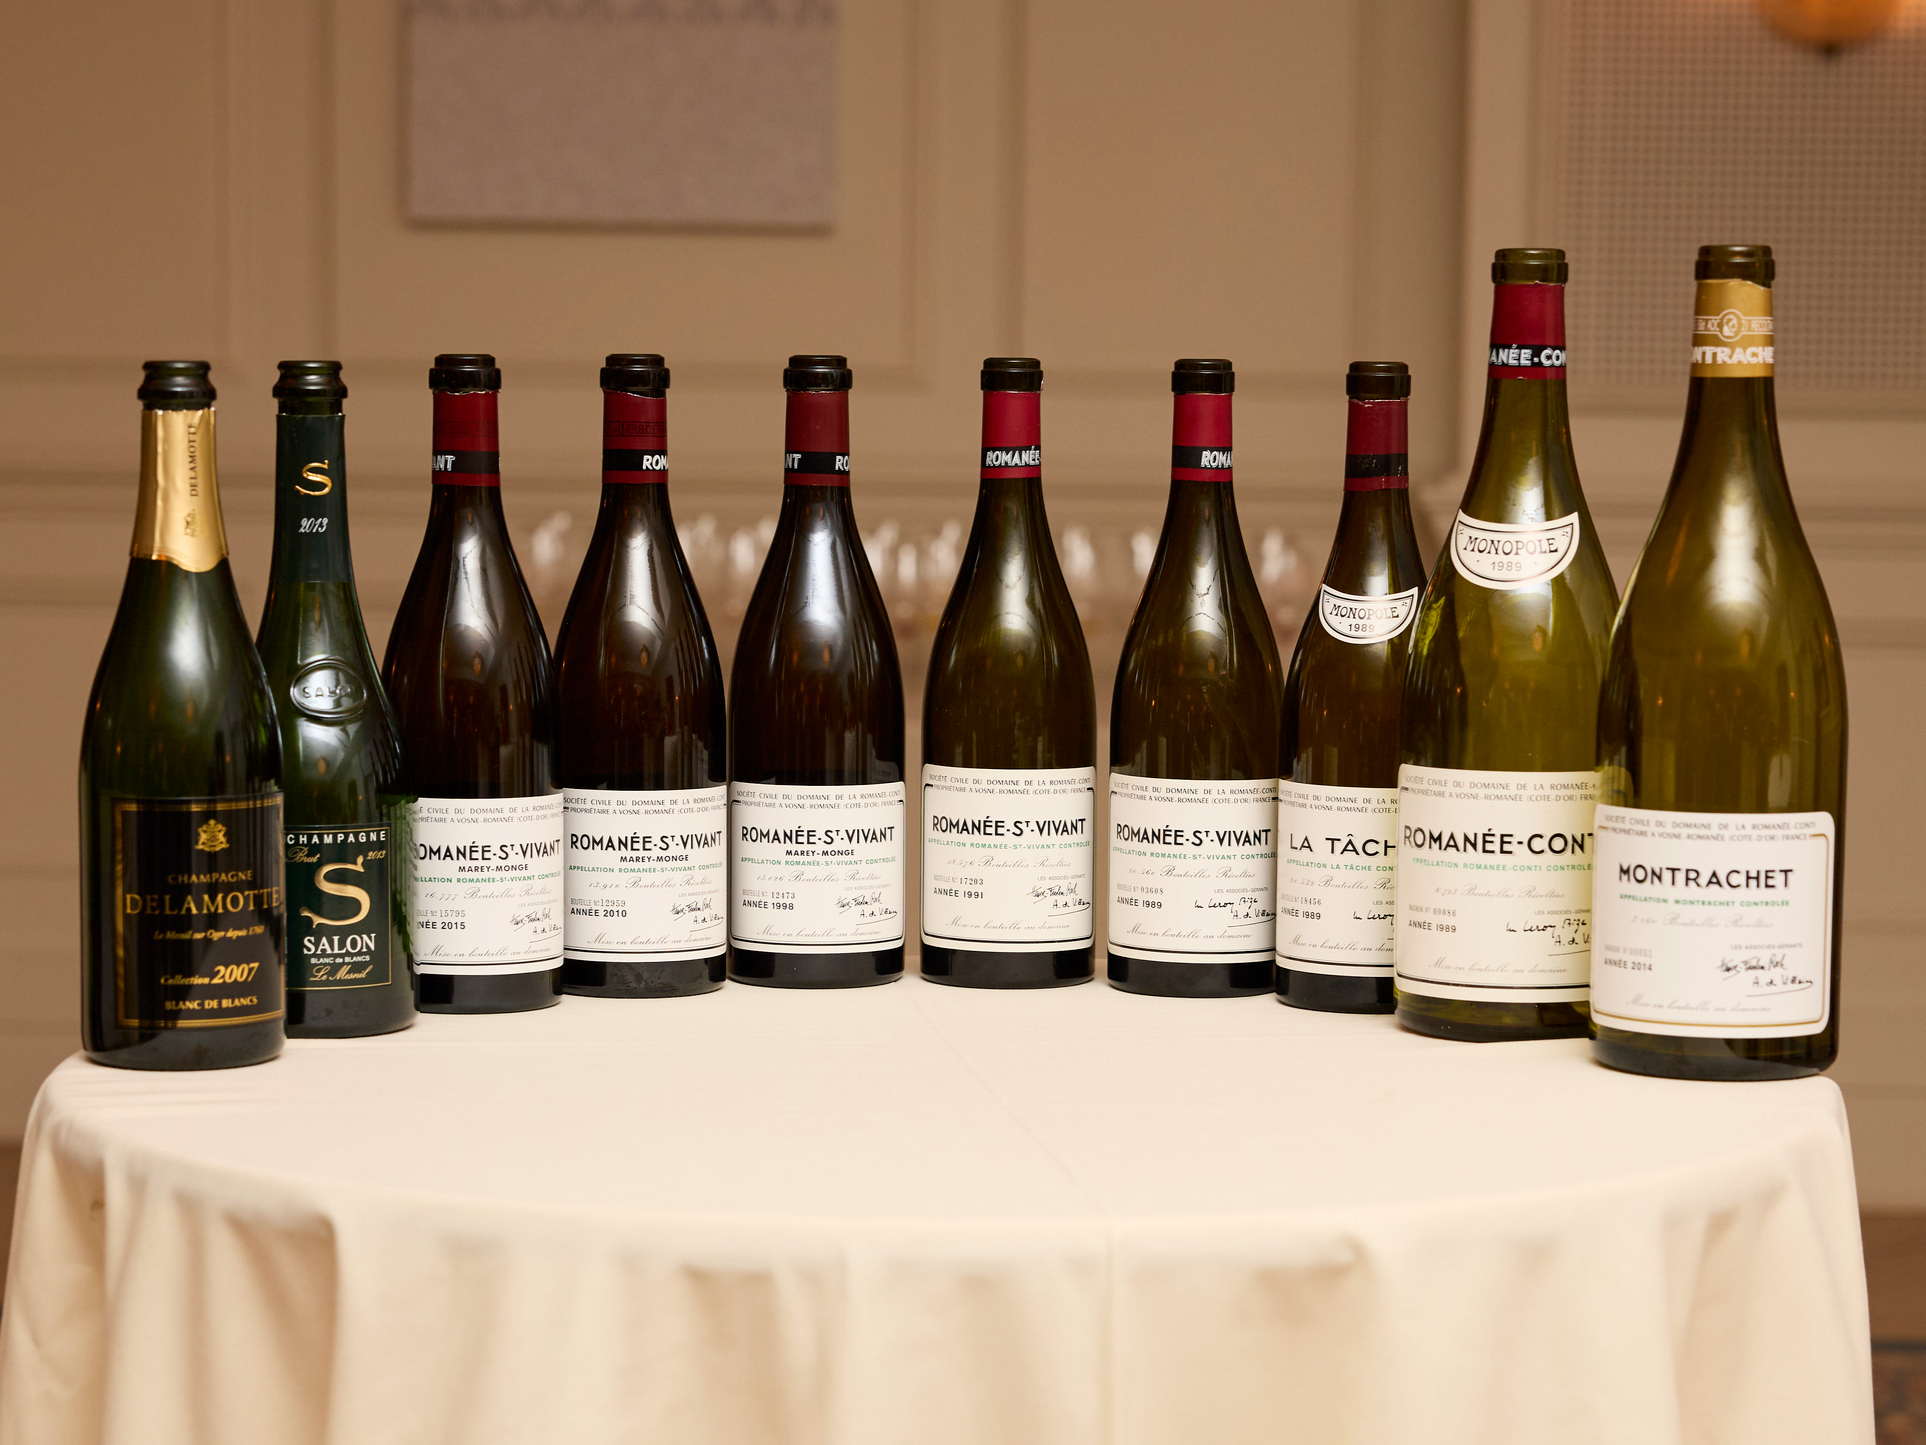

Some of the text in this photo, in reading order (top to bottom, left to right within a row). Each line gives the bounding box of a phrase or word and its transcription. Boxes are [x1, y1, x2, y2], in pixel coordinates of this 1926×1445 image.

[188, 422, 198, 498] DELAMOTTE
[294, 460, 332, 496] S
[299, 518, 328, 533] 2013
[1463, 535, 1558, 556] MONOPOLE
[1491, 561, 1522, 572] 1989
[1329, 604, 1400, 620] MONOPOLE
[1348, 623, 1375, 633] 1989
[950, 776, 968, 785] CIVILE
[986, 778, 1020, 786] DOMAINE
[1427, 778, 1448, 788] CIVILE
[1469, 781, 1510, 791] DOMAINE
[1516, 783, 1528, 791] DE
[1534, 783, 1544, 791] LA
[759, 792, 778, 800] CIVILE
[1132, 784, 1148, 792] CIVILE
[1165, 787, 1199, 795] DOMAINE
[785, 802, 840, 810] VOSNE-ROMANÉE
[1326, 796, 1358, 804] DOMAINE
[570, 806, 675, 816] PROPRIÉTAIRE VOSNE-ROMANÉE
[1655, 819, 1746, 830] DU DOMAINE DE LA
[287, 830, 386, 845] CHAMPAGNE
[928, 838, 966, 848] APPELLATION
[1059, 840, 1090, 849] CONTROLÉE
[1403, 825, 1594, 855] ROMANÉE-CON
[1782, 833, 1807, 841] FRANCE
[419, 839, 561, 861] OMANÉE-ST-VIVANT
[1290, 833, 1396, 857] LA TÂCH
[286, 846, 320, 863] Brut
[366, 850, 386, 860] 2013
[620, 855, 689, 863] MAREY-MONGE
[741, 857, 781, 865] APPELLATION
[1241, 851, 1276, 860] CONTROLÉE
[458, 864, 529, 873] MAREY-MONGE
[569, 865, 614, 873] APPELLATION
[1287, 858, 1327, 869] APPELLATION
[1344, 862, 1372, 871] TÂCHE
[1412, 857, 1542, 872] APPELLATION ROMANÉE-CONTI
[168, 870, 253, 885] CHAMPAGNE
[959, 877, 984, 885] 17203
[1618, 862, 1794, 889] MONTRACHET
[300, 855, 370, 929] S
[771, 891, 795, 899] 12473
[933, 887, 983, 899] ANNÉE 1991
[1140, 886, 1163, 895] 03608
[125, 887, 280, 914] DELAMOTTE
[600, 898, 626, 907] 12959
[742, 899, 794, 910] ANNÉE 1998
[1117, 896, 1162, 909] ANNÉE 1989
[1619, 893, 1790, 907] APPELLATION MONTRACHET CONTROLÉE
[439, 909, 466, 918] 15795
[570, 907, 627, 918] ANNÉE 2010
[1281, 906, 1321, 920] ANNÉE 1989
[441, 922, 466, 930] 2015
[946, 915, 1021, 930] Mise bouteille
[1408, 919, 1457, 933] ANNÉE 1989
[154, 931, 164, 939] Le
[193, 931, 205, 939] sur
[207, 929, 225, 941] Oger
[226, 927, 248, 940] depuis
[757, 924, 835, 937] Mise bouteille
[1127, 922, 1200, 939] Mise bouteille
[303, 933, 376, 955] SALON
[588, 932, 669, 945] Mise bouteille
[1319, 939, 1359, 951] bouteille
[424, 945, 508, 958] Mise bouteille
[345, 955, 370, 963] BLANCS
[1604, 957, 1653, 972] ANNÉE 2014
[161, 962, 260, 986] Collection 2007
[310, 965, 373, 981] Le Mesnil
[165, 996, 257, 1010] BLANC DE BLANCS
